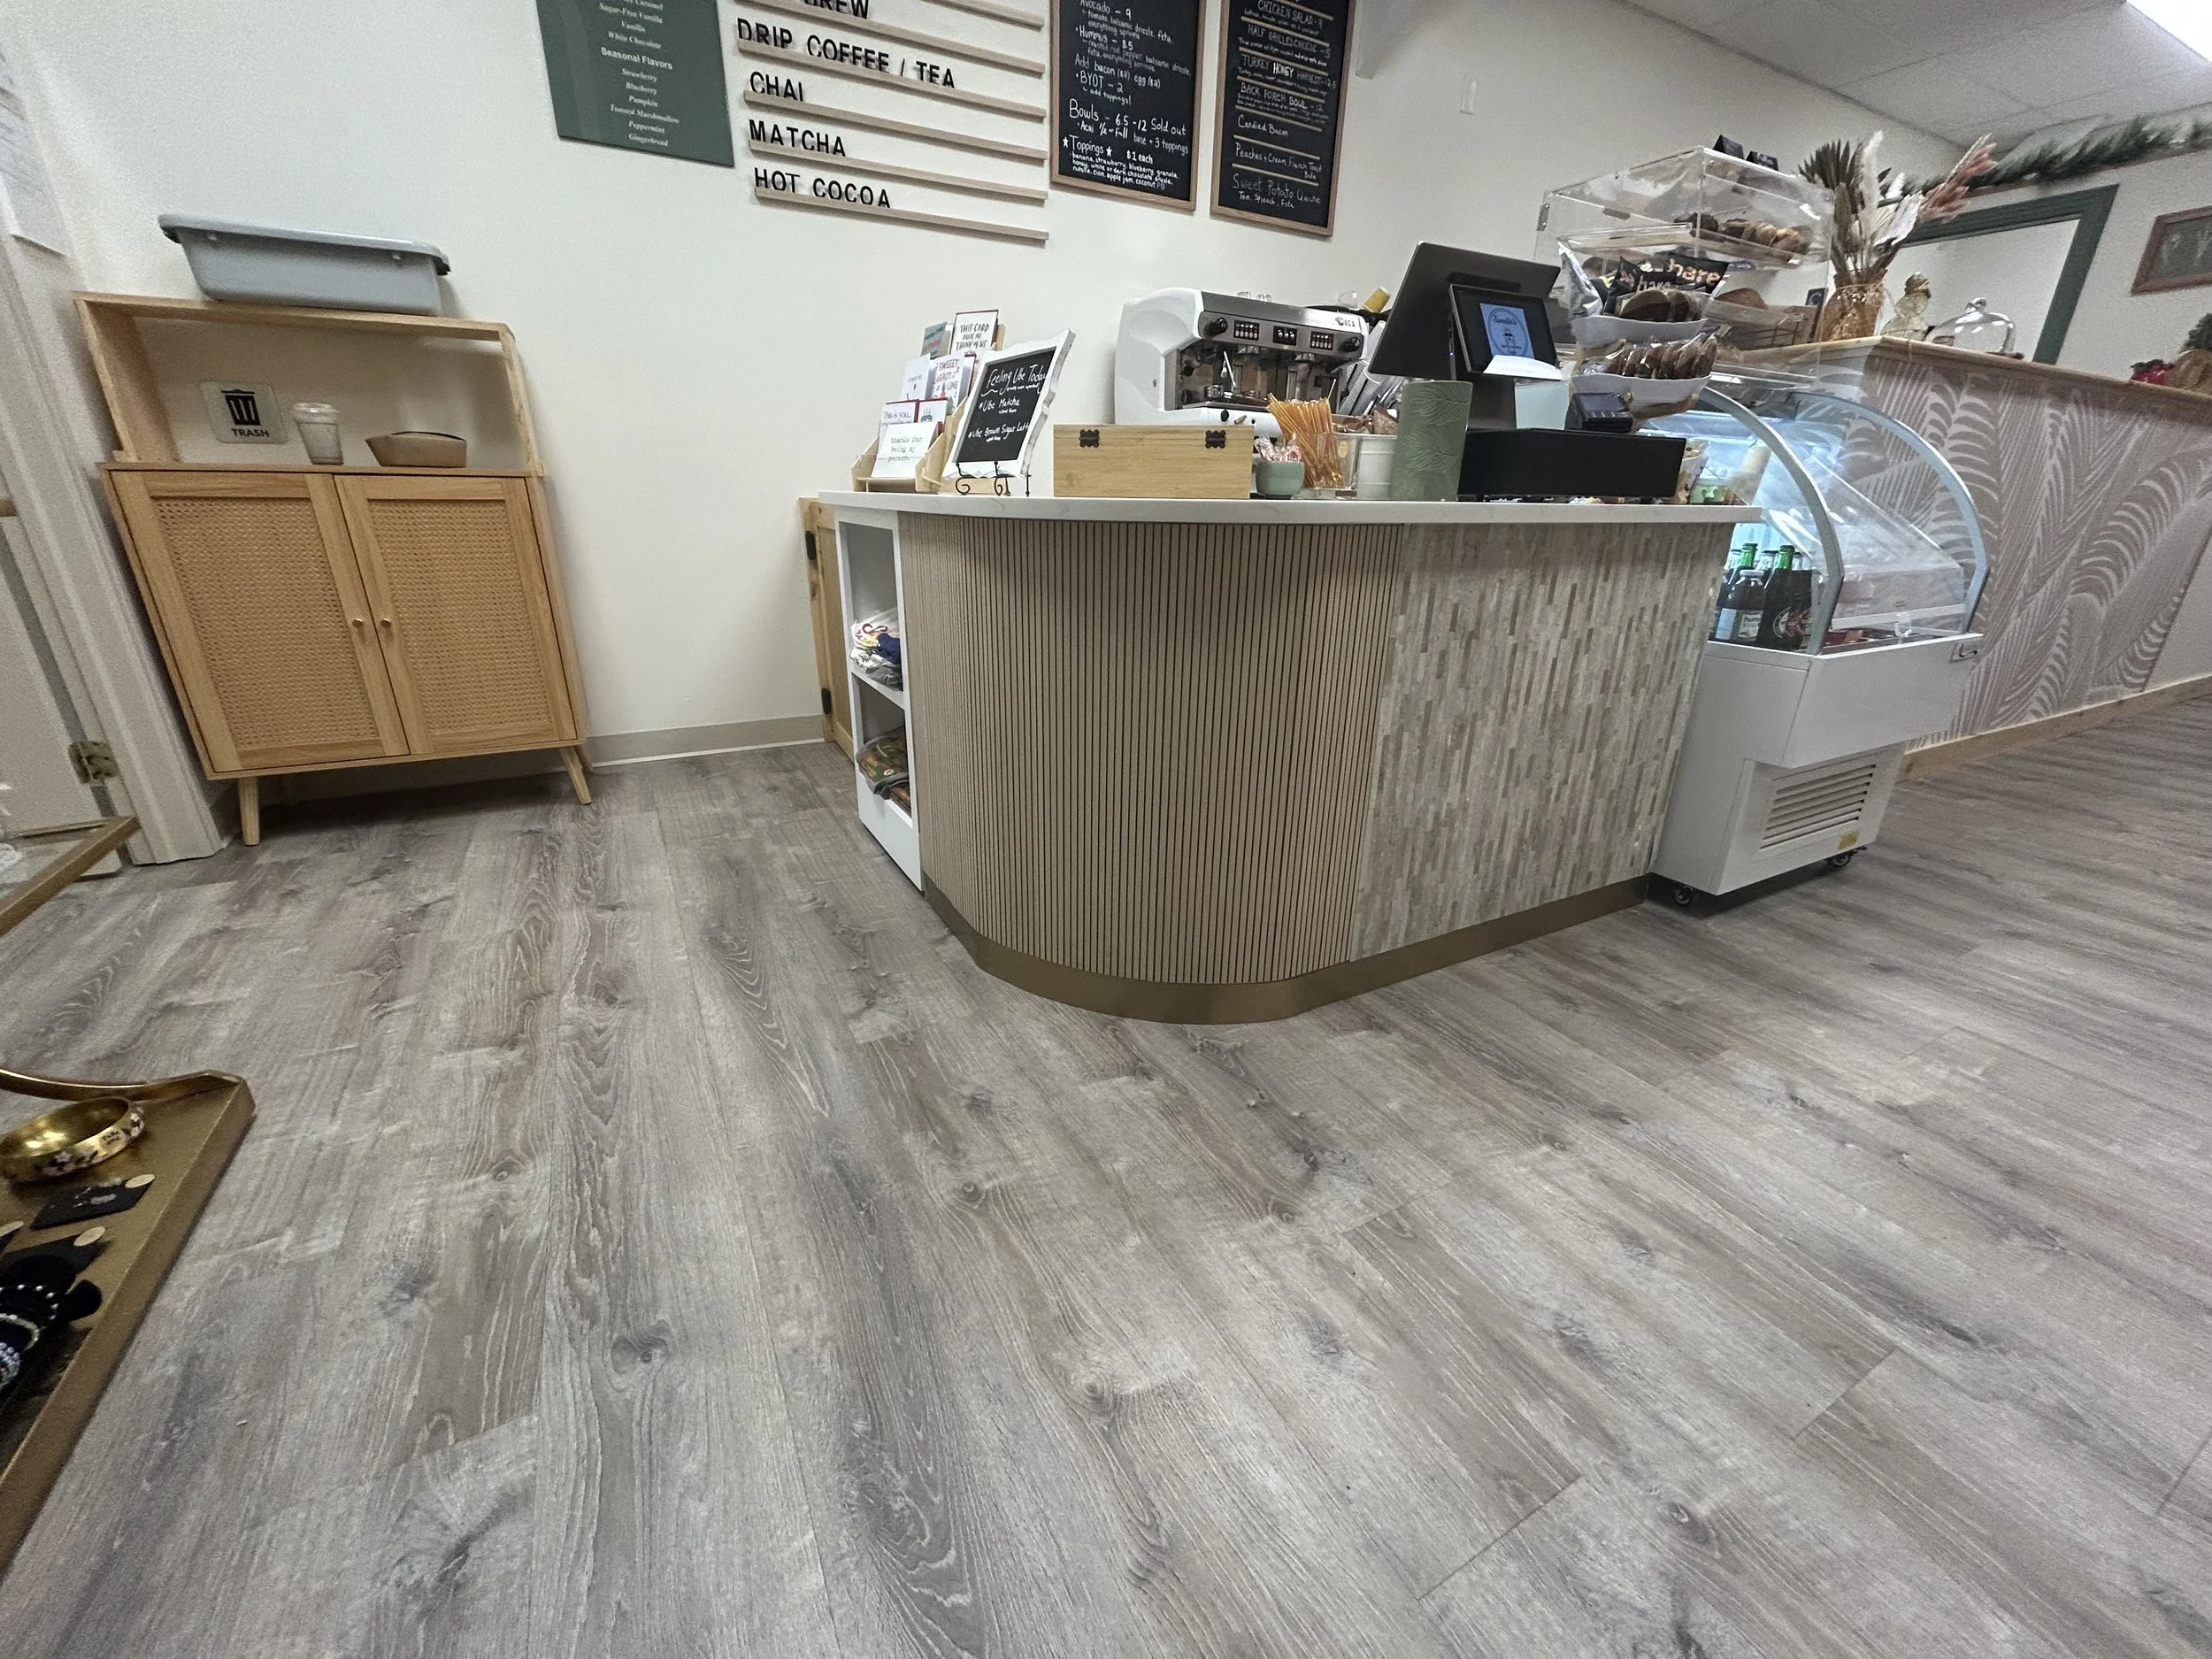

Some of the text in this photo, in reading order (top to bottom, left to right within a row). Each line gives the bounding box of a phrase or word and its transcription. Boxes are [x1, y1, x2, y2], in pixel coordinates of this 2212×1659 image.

[1125, 8, 1132, 21] 9
[1258, 0, 1290, 18] CHICKEN
[1292, 11, 1313, 24] SALAD
[1079, 25, 1108, 42] Hummus
[1248, 24, 1265, 37] HALF
[1269, 31, 1293, 47] GRILLED
[601, 46, 673, 70] Seasonal Flavors
[737, 18, 792, 49] DRIP
[806, 35, 889, 73] COFFEE
[916, 60, 955, 88] TEA
[1241, 53, 1269, 70] TURKEY
[1272, 62, 1294, 77] HONEY
[622, 68, 657, 82] Strawberry
[1075, 53, 1089, 69] Add
[1094, 62, 1115, 76] bacon
[1134, 74, 1146, 87] egg
[1079, 70, 1103, 89] BYOT
[1117, 83, 1123, 94] 2
[626, 81, 657, 96] Blueberry
[750, 71, 803, 102] CHAI
[1240, 82, 1260, 96] BACK
[1263, 89, 1286, 102] PORCH
[1289, 96, 1308, 109] BOWL
[629, 95, 658, 107] Pumpkin
[629, 120, 665, 134] Peppermint
[1069, 98, 1099, 121] Bowls
[1115, 113, 1129, 126] 6.5
[1150, 118, 1168, 132] Sold
[1171, 123, 1187, 135] out
[1238, 114, 1288, 136] Candied Bacon
[628, 134, 668, 147] Gingerbread
[749, 119, 846, 157] MATCHA
[1069, 134, 1103, 156] Toppings
[1139, 153, 1154, 165] each
[1115, 127, 1128, 139] Full
[1155, 137, 1161, 148] 3
[1162, 139, 1189, 157] toppings
[1235, 142, 1263, 161] Peaches
[1268, 153, 1286, 166] Cream
[1288, 157, 1308, 170] French
[1308, 161, 1322, 173] Toast
[754, 167, 891, 209] HOT COCOA
[1233, 173, 1263, 192] Sweet
[1267, 180, 1294, 199] Potato
[960, 322, 989, 334] THIS CARD
[987, 368, 1013, 396] Feeling
[1013, 367, 1025, 384] Ube
[982, 400, 995, 412] Ube
[998, 396, 1020, 409] Matcha
[231, 428, 270, 439] TRASH
[1001, 424, 1016, 440] Sugar
[1017, 421, 1030, 432] Latt
